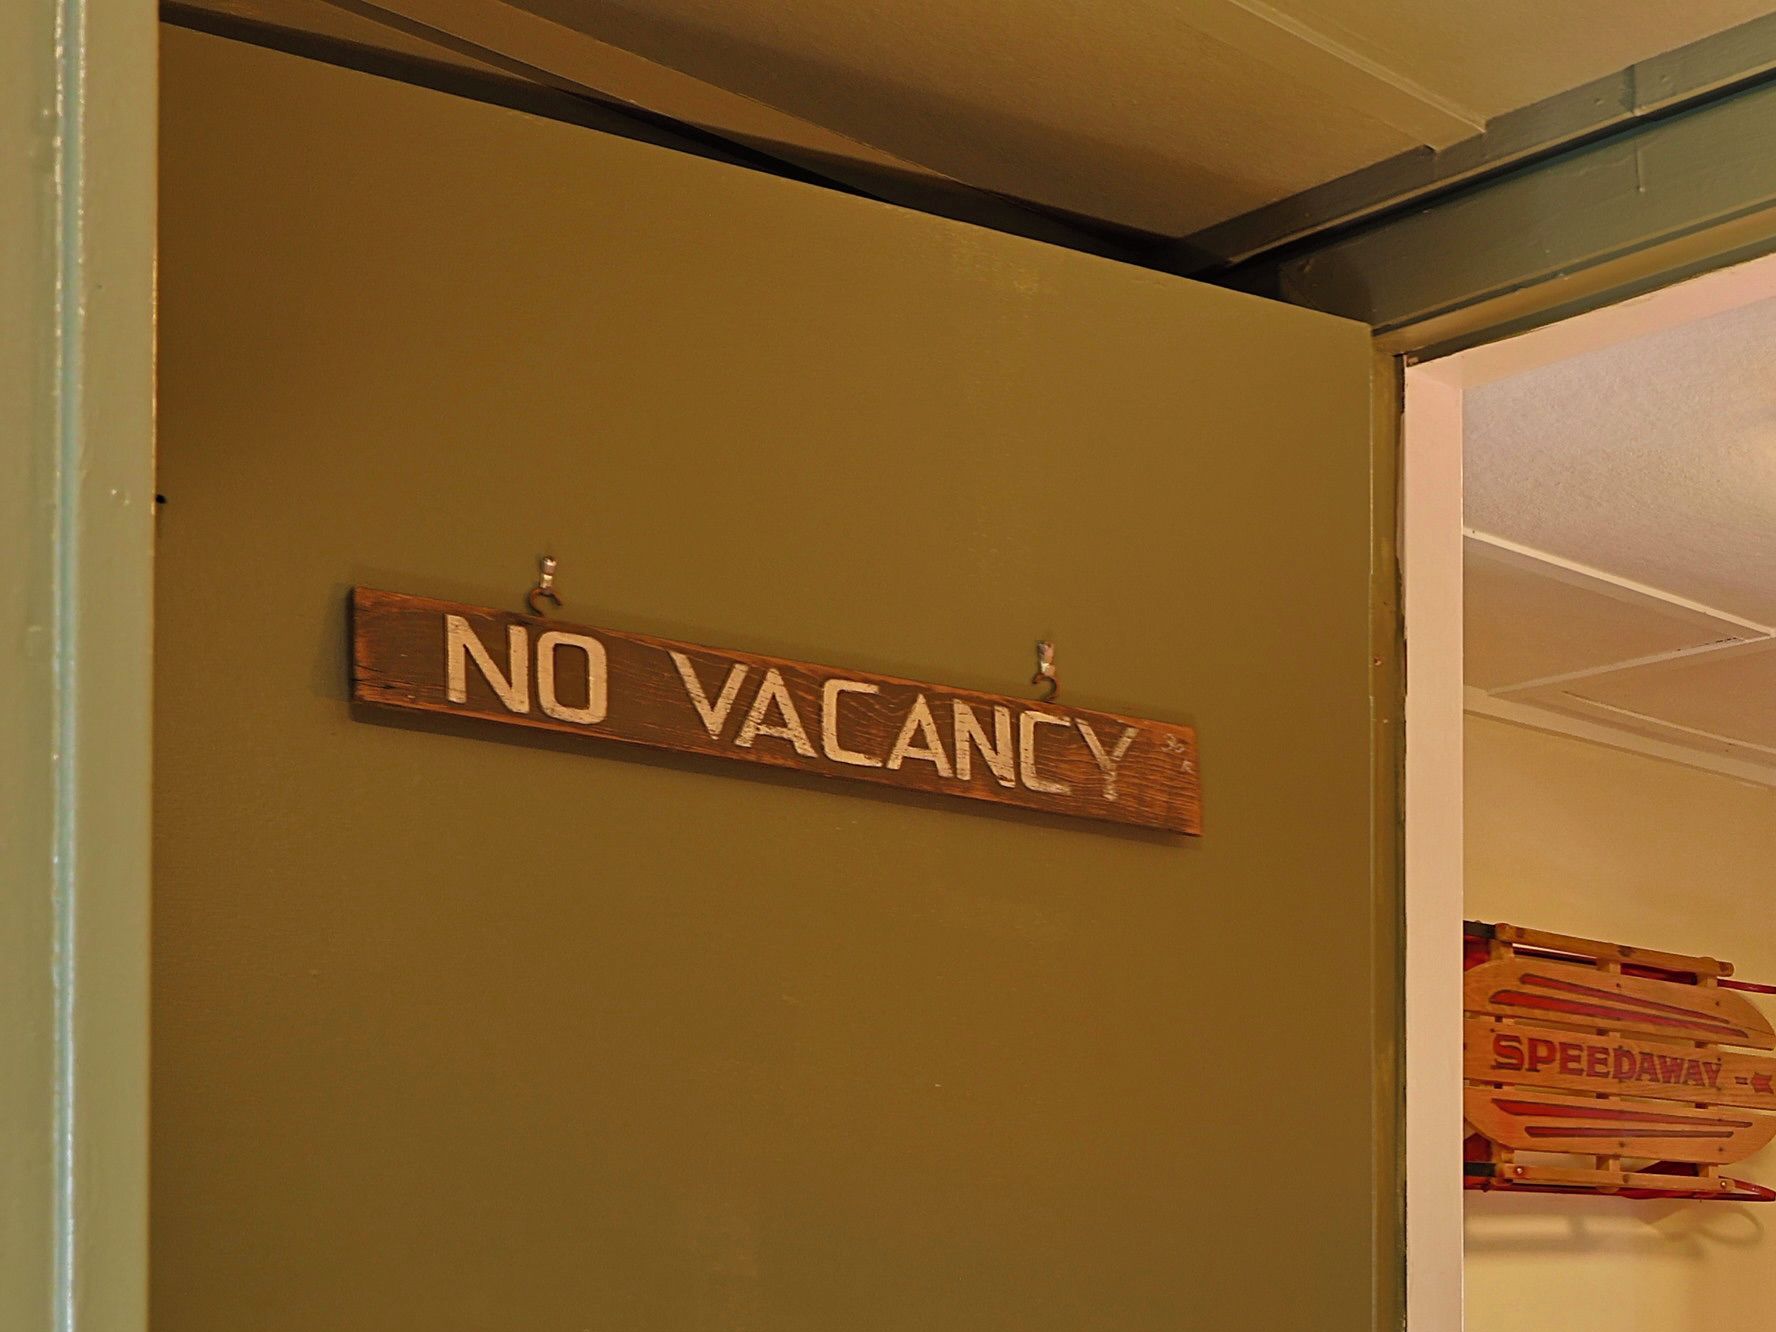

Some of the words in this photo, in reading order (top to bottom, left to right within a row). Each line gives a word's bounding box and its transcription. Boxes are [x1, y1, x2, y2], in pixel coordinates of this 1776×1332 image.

[444, 612, 608, 726] NO
[668, 650, 1139, 801] VACANCY
[1490, 1032, 1723, 1088] SPEEDAWAY
